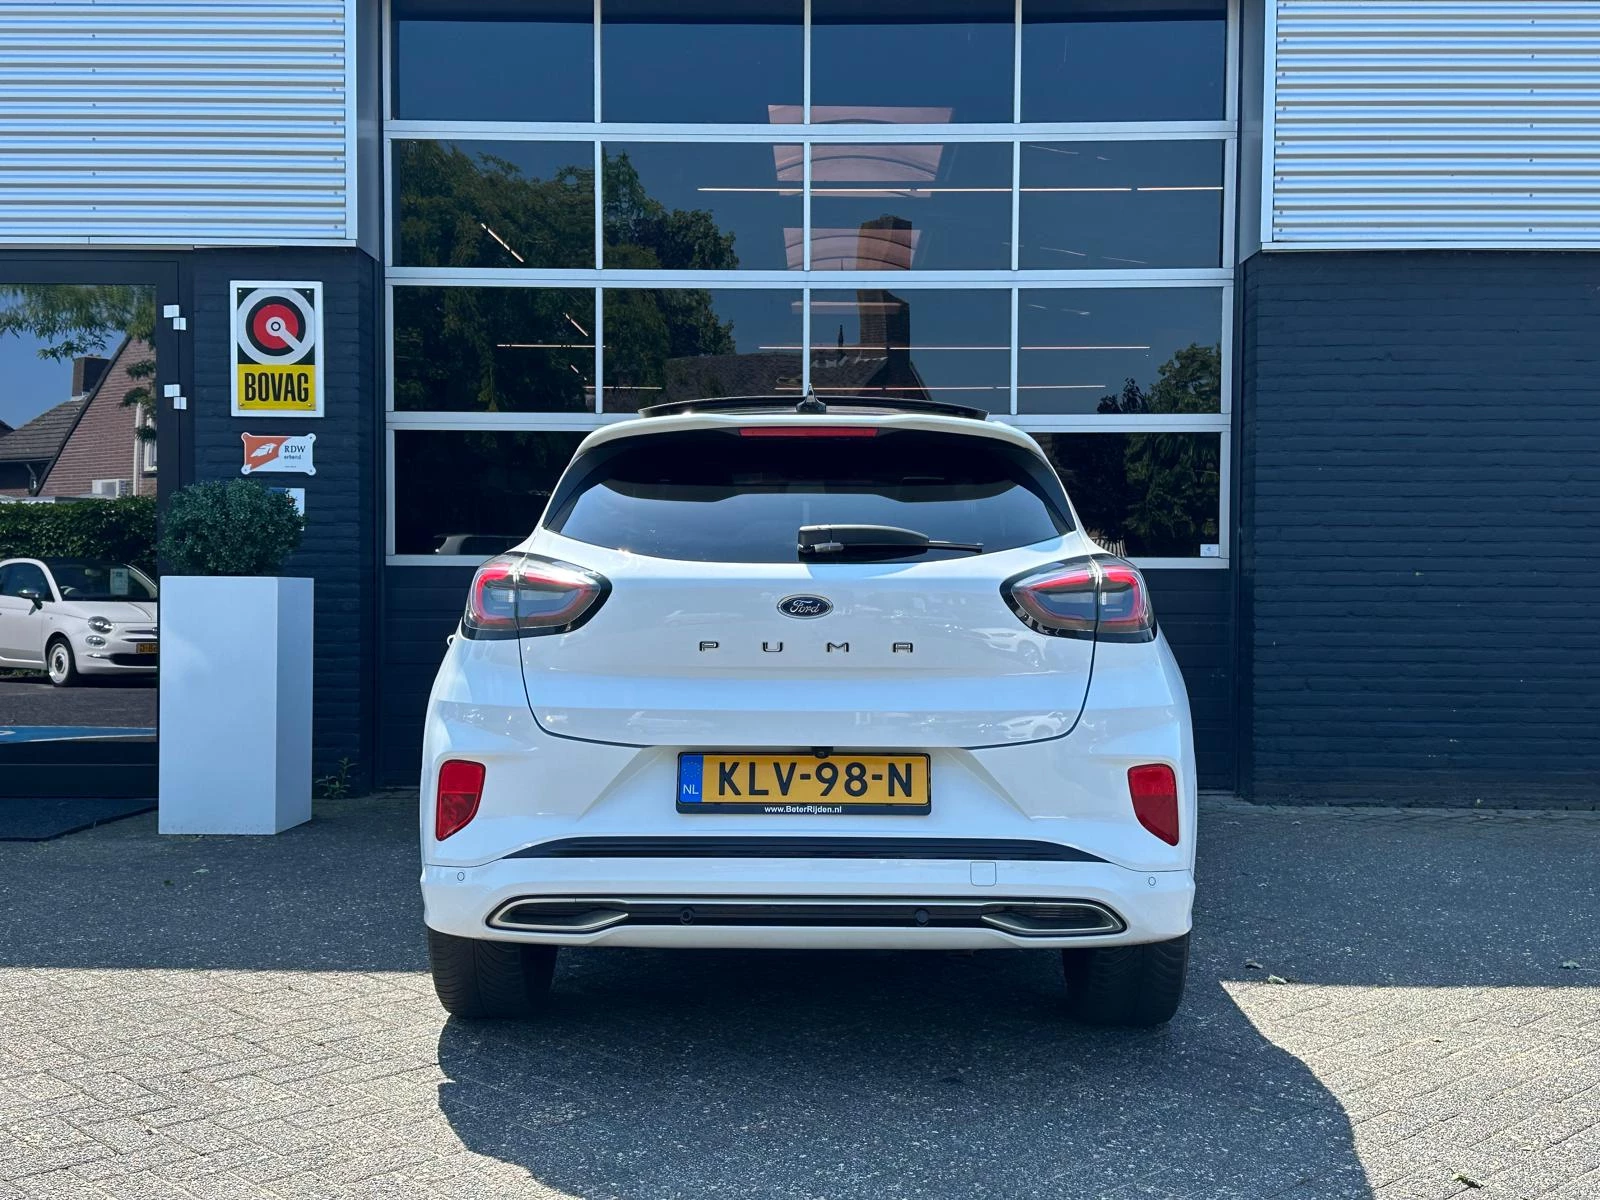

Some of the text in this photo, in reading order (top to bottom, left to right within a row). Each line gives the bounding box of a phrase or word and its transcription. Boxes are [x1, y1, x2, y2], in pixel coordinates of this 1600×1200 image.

[244, 372, 309, 402] BOVAG
[284, 445, 306, 453] RDW
[789, 599, 820, 614] Ford
[699, 641, 913, 653] PUMA
[718, 761, 912, 797] KLV-98-N
[683, 784, 699, 795] NL
[764, 805, 842, 814] www.BeterRijden.nl
